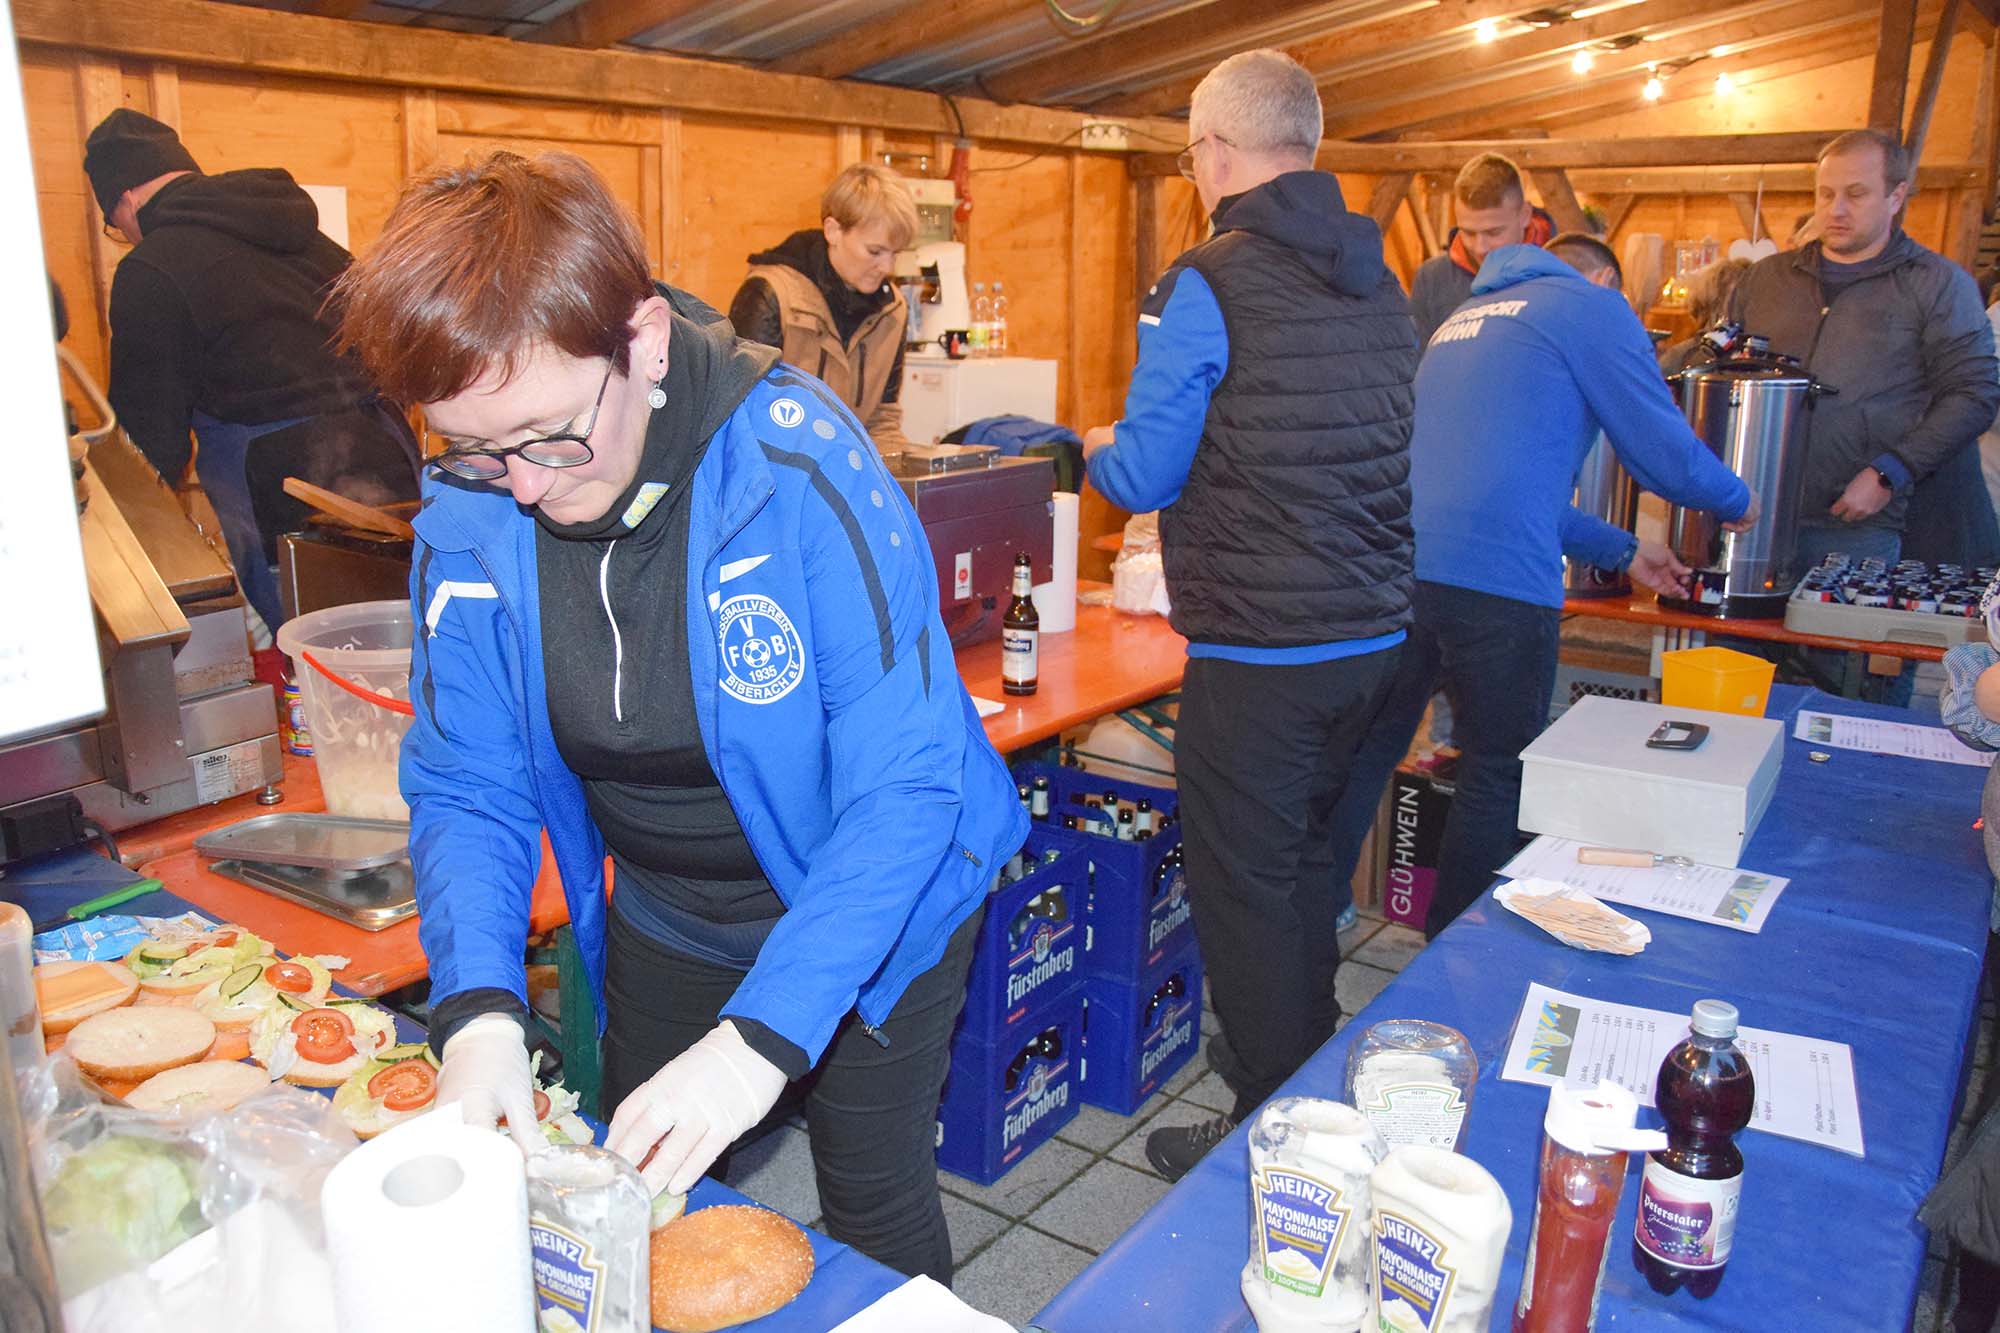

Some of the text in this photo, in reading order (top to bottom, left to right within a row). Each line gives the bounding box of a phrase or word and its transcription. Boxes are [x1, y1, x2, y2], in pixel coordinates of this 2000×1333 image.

[718, 600, 791, 641] SSBALLVEREIN
[739, 616, 754, 637] V
[728, 635, 787, 667] F B
[725, 674, 790, 699] BIBERACH
[748, 665, 777, 683] 1935
[1391, 786, 1420, 916] GLÜHWEIN
[1007, 945, 1074, 1009] Fürstenberg
[1141, 1019, 1192, 1082] Fürstenberg
[1273, 1176, 1329, 1207] HEINZ
[1263, 1198, 1337, 1233] MAYONNAISE
[1266, 1213, 1282, 1230] DAS
[1284, 1221, 1328, 1243] ORIGINAL
[1643, 1193, 1704, 1229] Peterstaler
[531, 1230, 580, 1262] HEINZ
[1386, 1219, 1437, 1261] HEINZ
[534, 1257, 593, 1291] AYONNAISE
[1377, 1242, 1443, 1291] MAYONNAISE
[1380, 1259, 1395, 1277] DAS
[1396, 1270, 1435, 1300] ORIGINAL
